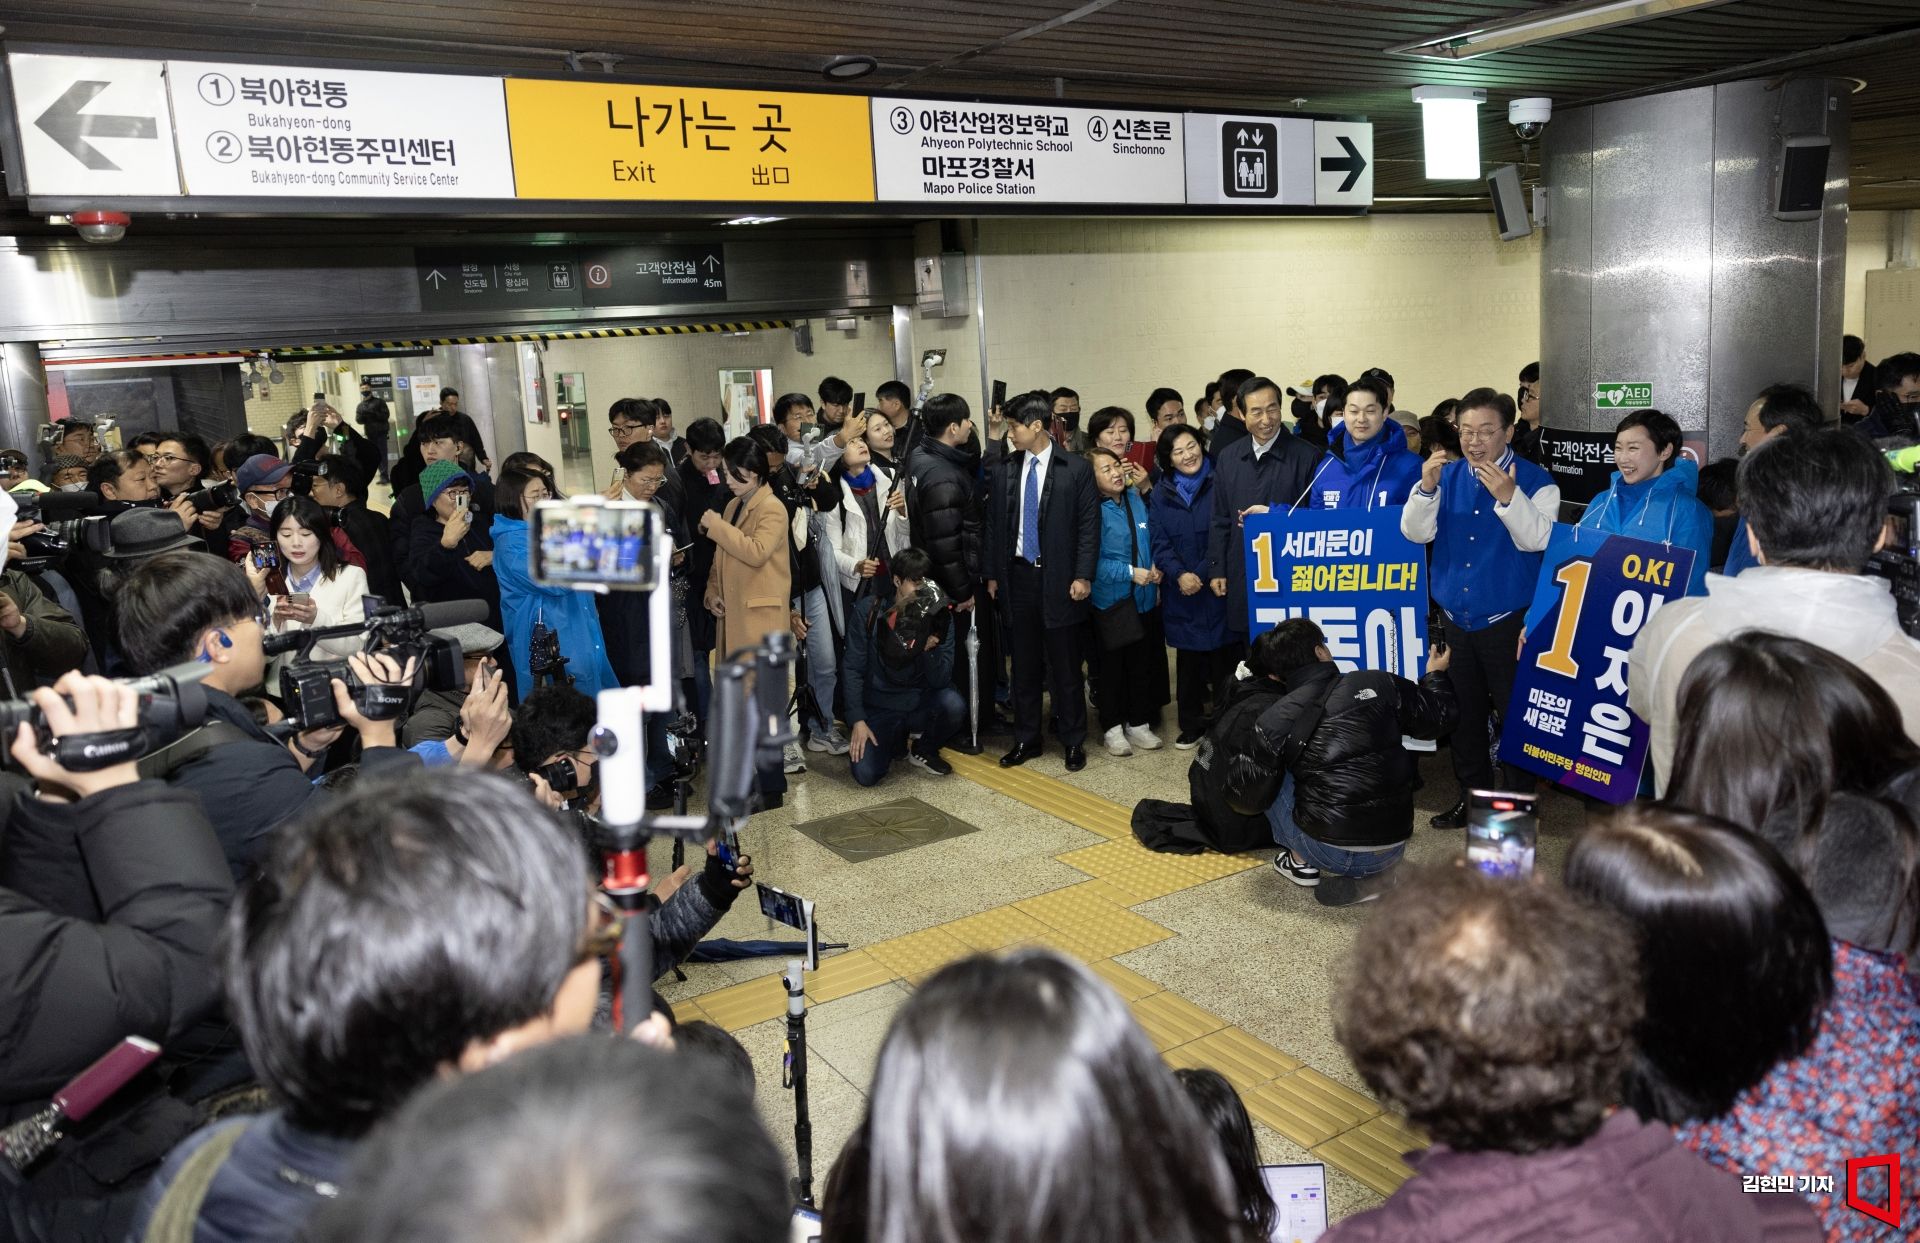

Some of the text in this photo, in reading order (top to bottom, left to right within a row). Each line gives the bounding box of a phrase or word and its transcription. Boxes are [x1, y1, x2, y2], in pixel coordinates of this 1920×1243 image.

[240, 77, 348, 109] 북아현동
[248, 113, 352, 131] Bukahyeon-dong
[606, 96, 791, 153] 나가는 곳
[919, 109, 1070, 137] 아현산업정보학교
[1112, 118, 1172, 141] 신촌로
[248, 135, 456, 166] 북아현동주민센터
[921, 136, 1073, 153] Ahyeon Polytechnic School
[1112, 142, 1166, 155] Sinchonno
[251, 170, 459, 187] Bukahyeon-dong Community Service Center
[612, 159, 656, 183] Exit
[751, 164, 790, 186] 出口
[922, 156, 1035, 180] 마포경찰서
[923, 182, 1035, 196] Mapo Police Station
[636, 261, 697, 275] 고객안전실
[506, 278, 529, 287] 왕십리
[662, 276, 698, 285] Information
[703, 279, 722, 288] 45m
[1625, 387, 1650, 398] AED
[1552, 461, 1583, 475] Information
[1378, 491, 1388, 507] 1
[1281, 528, 1373, 558] 서대문이
[1251, 531, 1279, 593] 1
[1622, 554, 1675, 587] O.K!
[1291, 562, 1418, 592] 젊어집니다!
[1535, 559, 1592, 680] 1
[1255, 606, 1424, 684] 동아
[377, 696, 404, 704] SONY
[1528, 687, 1572, 717] 마포의
[1523, 707, 1567, 737] 새일꾼
[1523, 743, 1611, 785] 더불어민주당 영입인재
